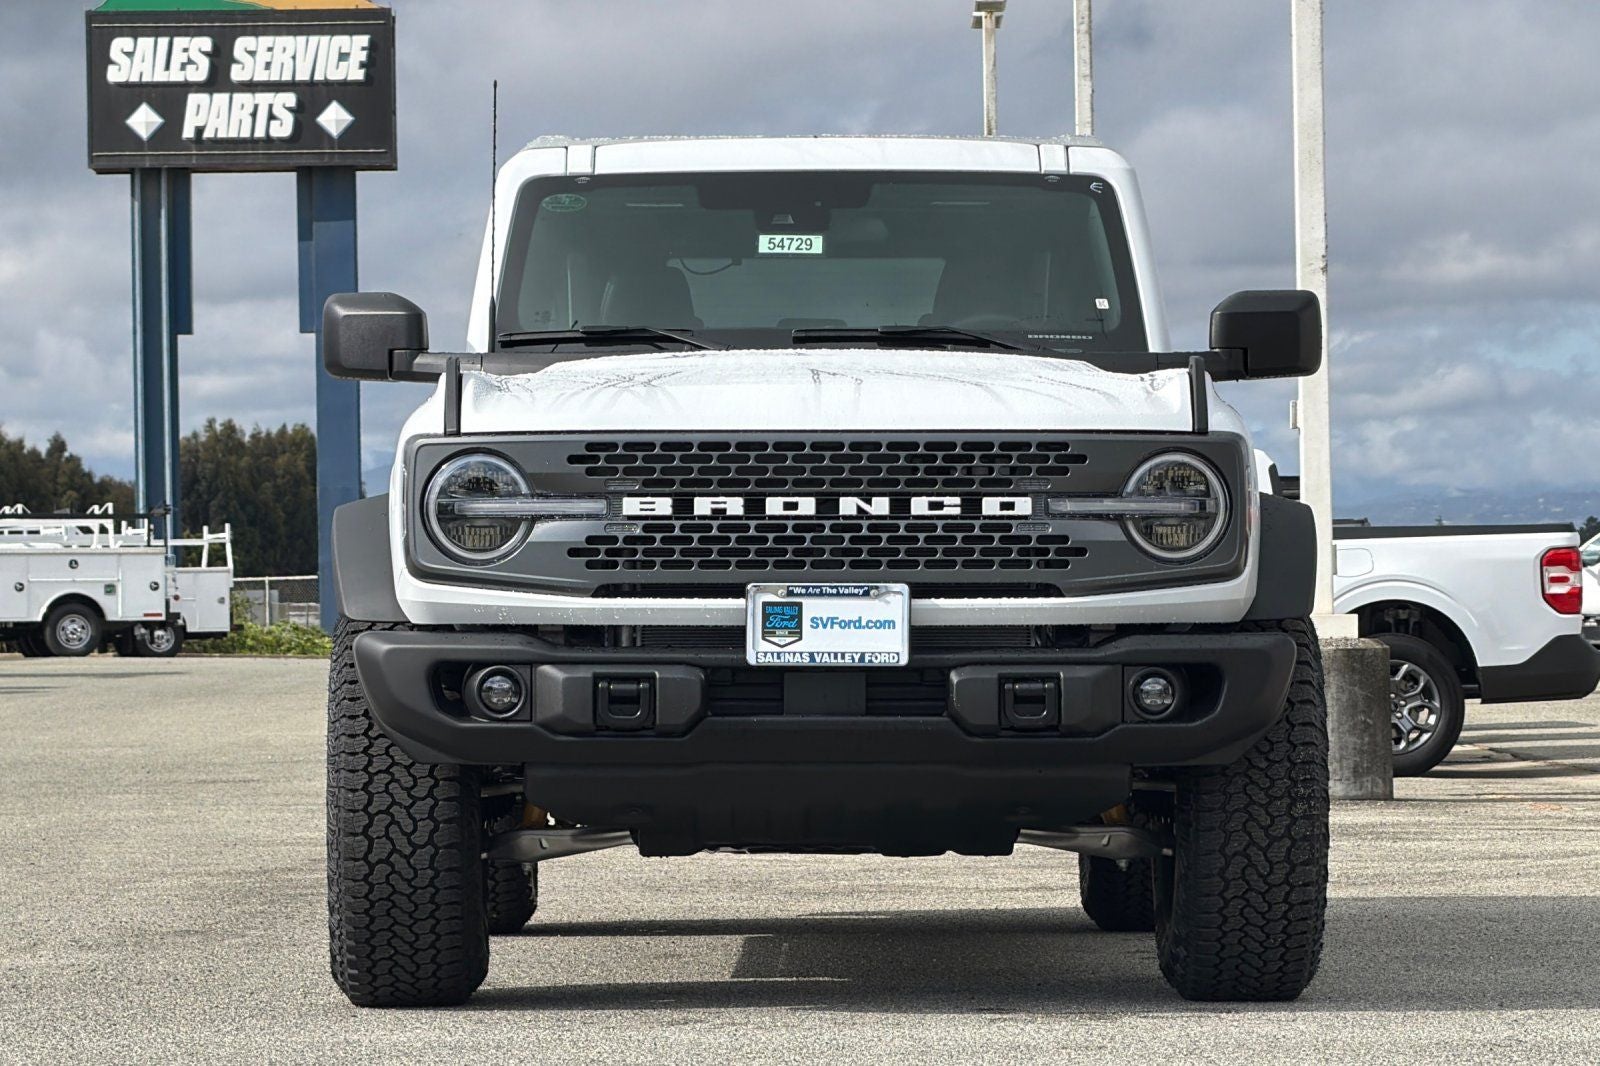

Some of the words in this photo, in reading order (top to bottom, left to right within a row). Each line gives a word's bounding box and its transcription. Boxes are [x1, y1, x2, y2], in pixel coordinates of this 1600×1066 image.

[106, 36, 213, 84] SALES
[230, 34, 371, 83] SERVICE
[182, 91, 297, 140] PARTS
[768, 237, 813, 251] 54729
[622, 496, 1033, 516] BRONCO
[808, 586, 821, 594] Are
[822, 586, 836, 594] The
[766, 614, 799, 628] Ford
[809, 616, 896, 630] SVFord.com
[756, 652, 810, 664] SALINAS
[813, 652, 860, 664] VALLEY
[864, 652, 899, 664] FORD
